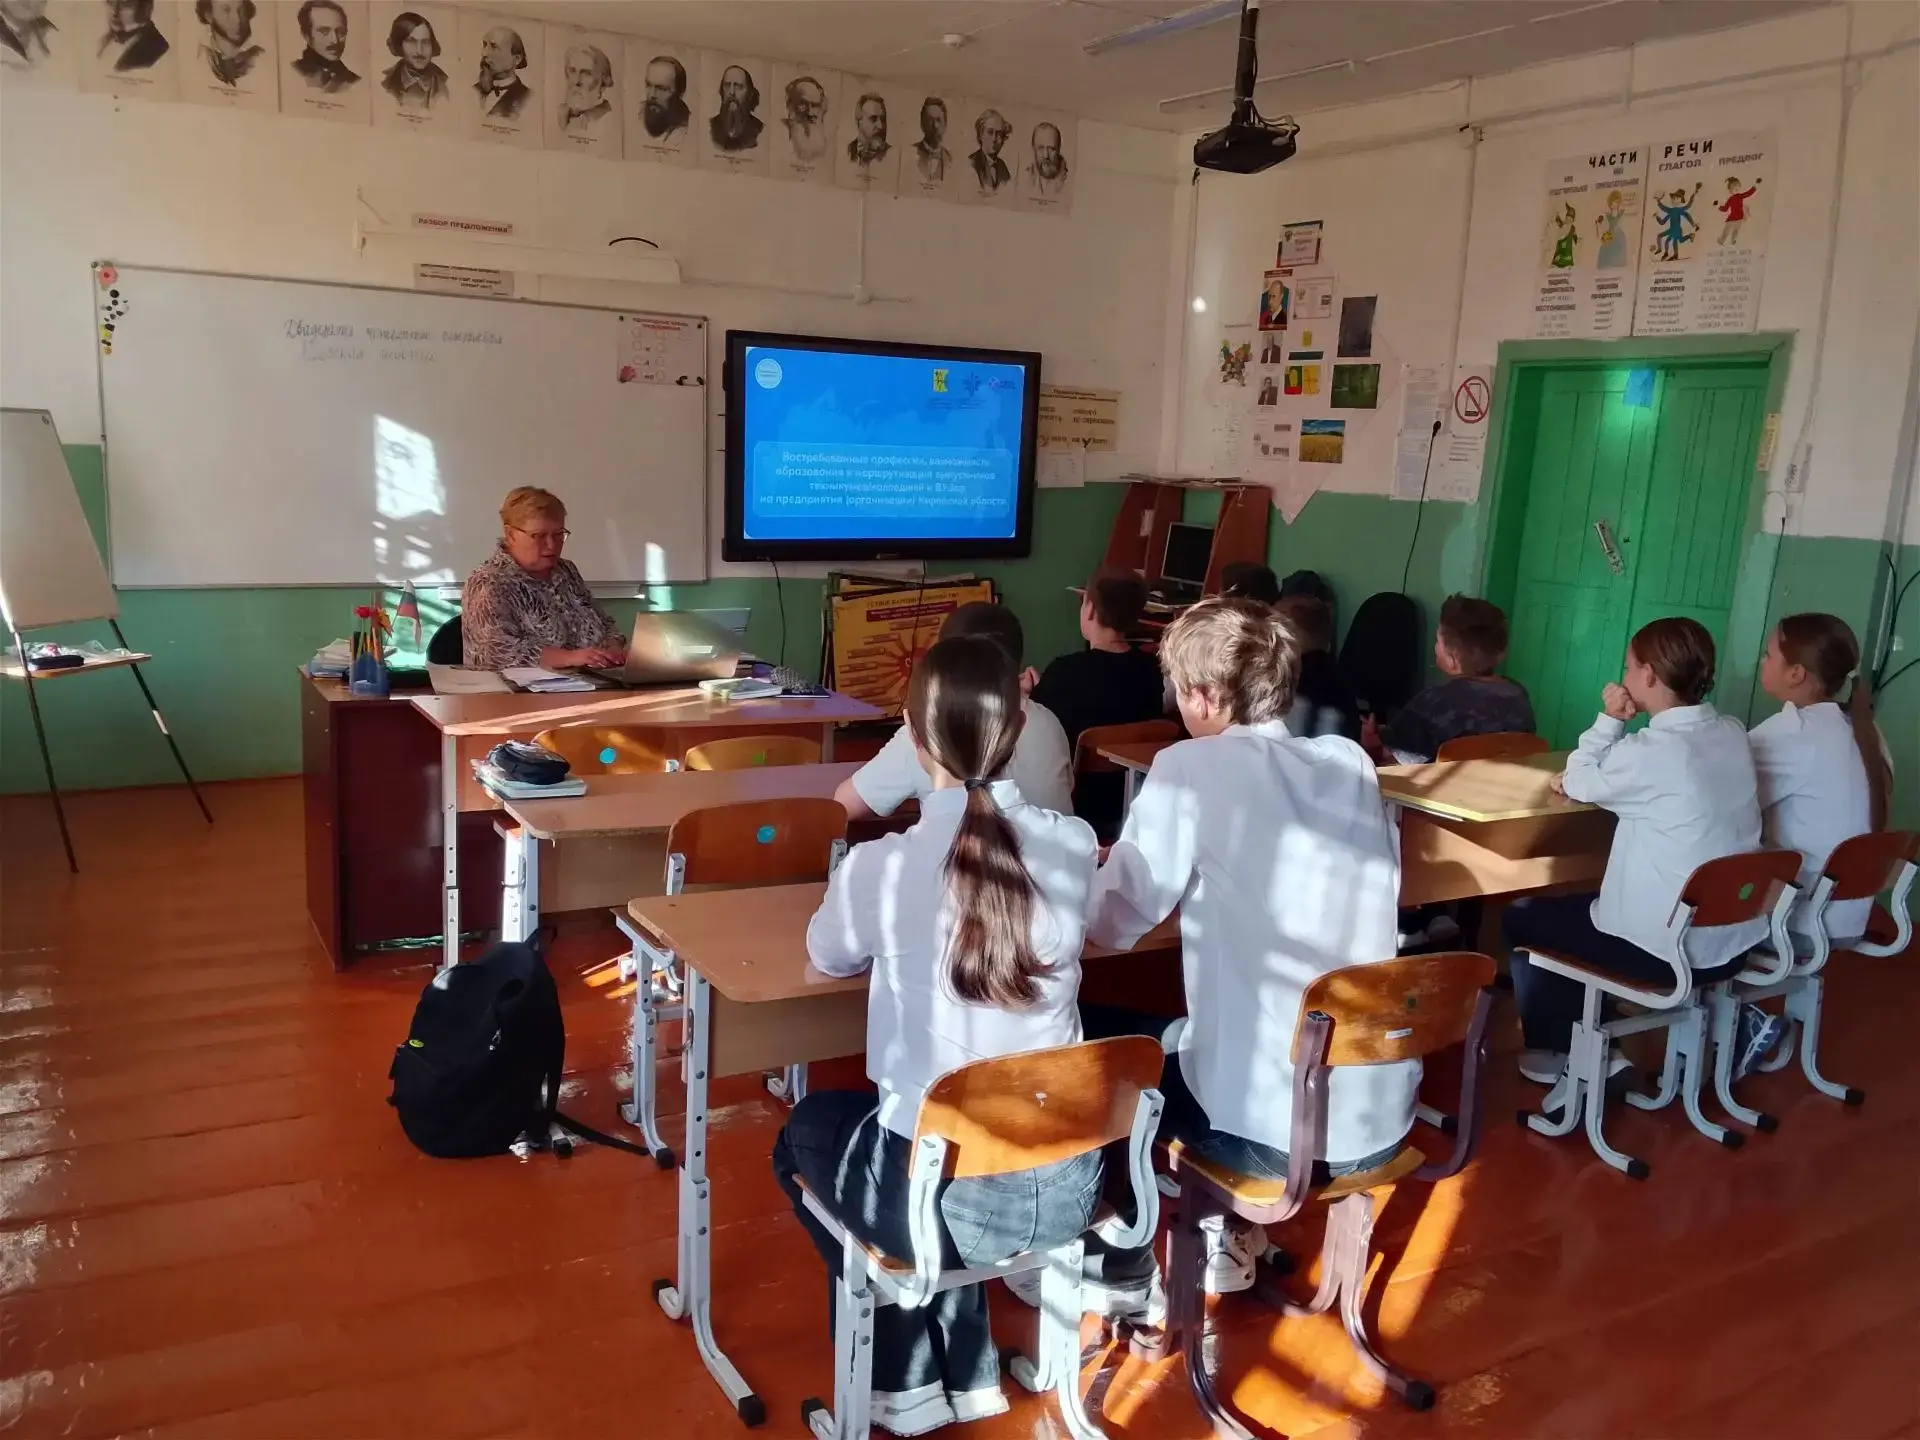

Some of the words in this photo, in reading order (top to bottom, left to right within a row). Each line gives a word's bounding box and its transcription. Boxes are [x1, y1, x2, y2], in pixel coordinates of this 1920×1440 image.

[1588, 151, 1638, 168] ЧАСТИ
[1664, 140, 1713, 158] РЕЧИ
[1718, 152, 1764, 166] ПРЕДЛОГ
[1658, 159, 1702, 172] ГЛАГОЛ
[418, 217, 448, 226] РАЗБОР
[450, 221, 508, 233] ПРЕДЛОЖЕНИЯ
[782, 451, 869, 464] Востребованные
[775, 464, 844, 478] образования
[760, 495, 773, 505] на
[775, 494, 843, 507] предприятия
